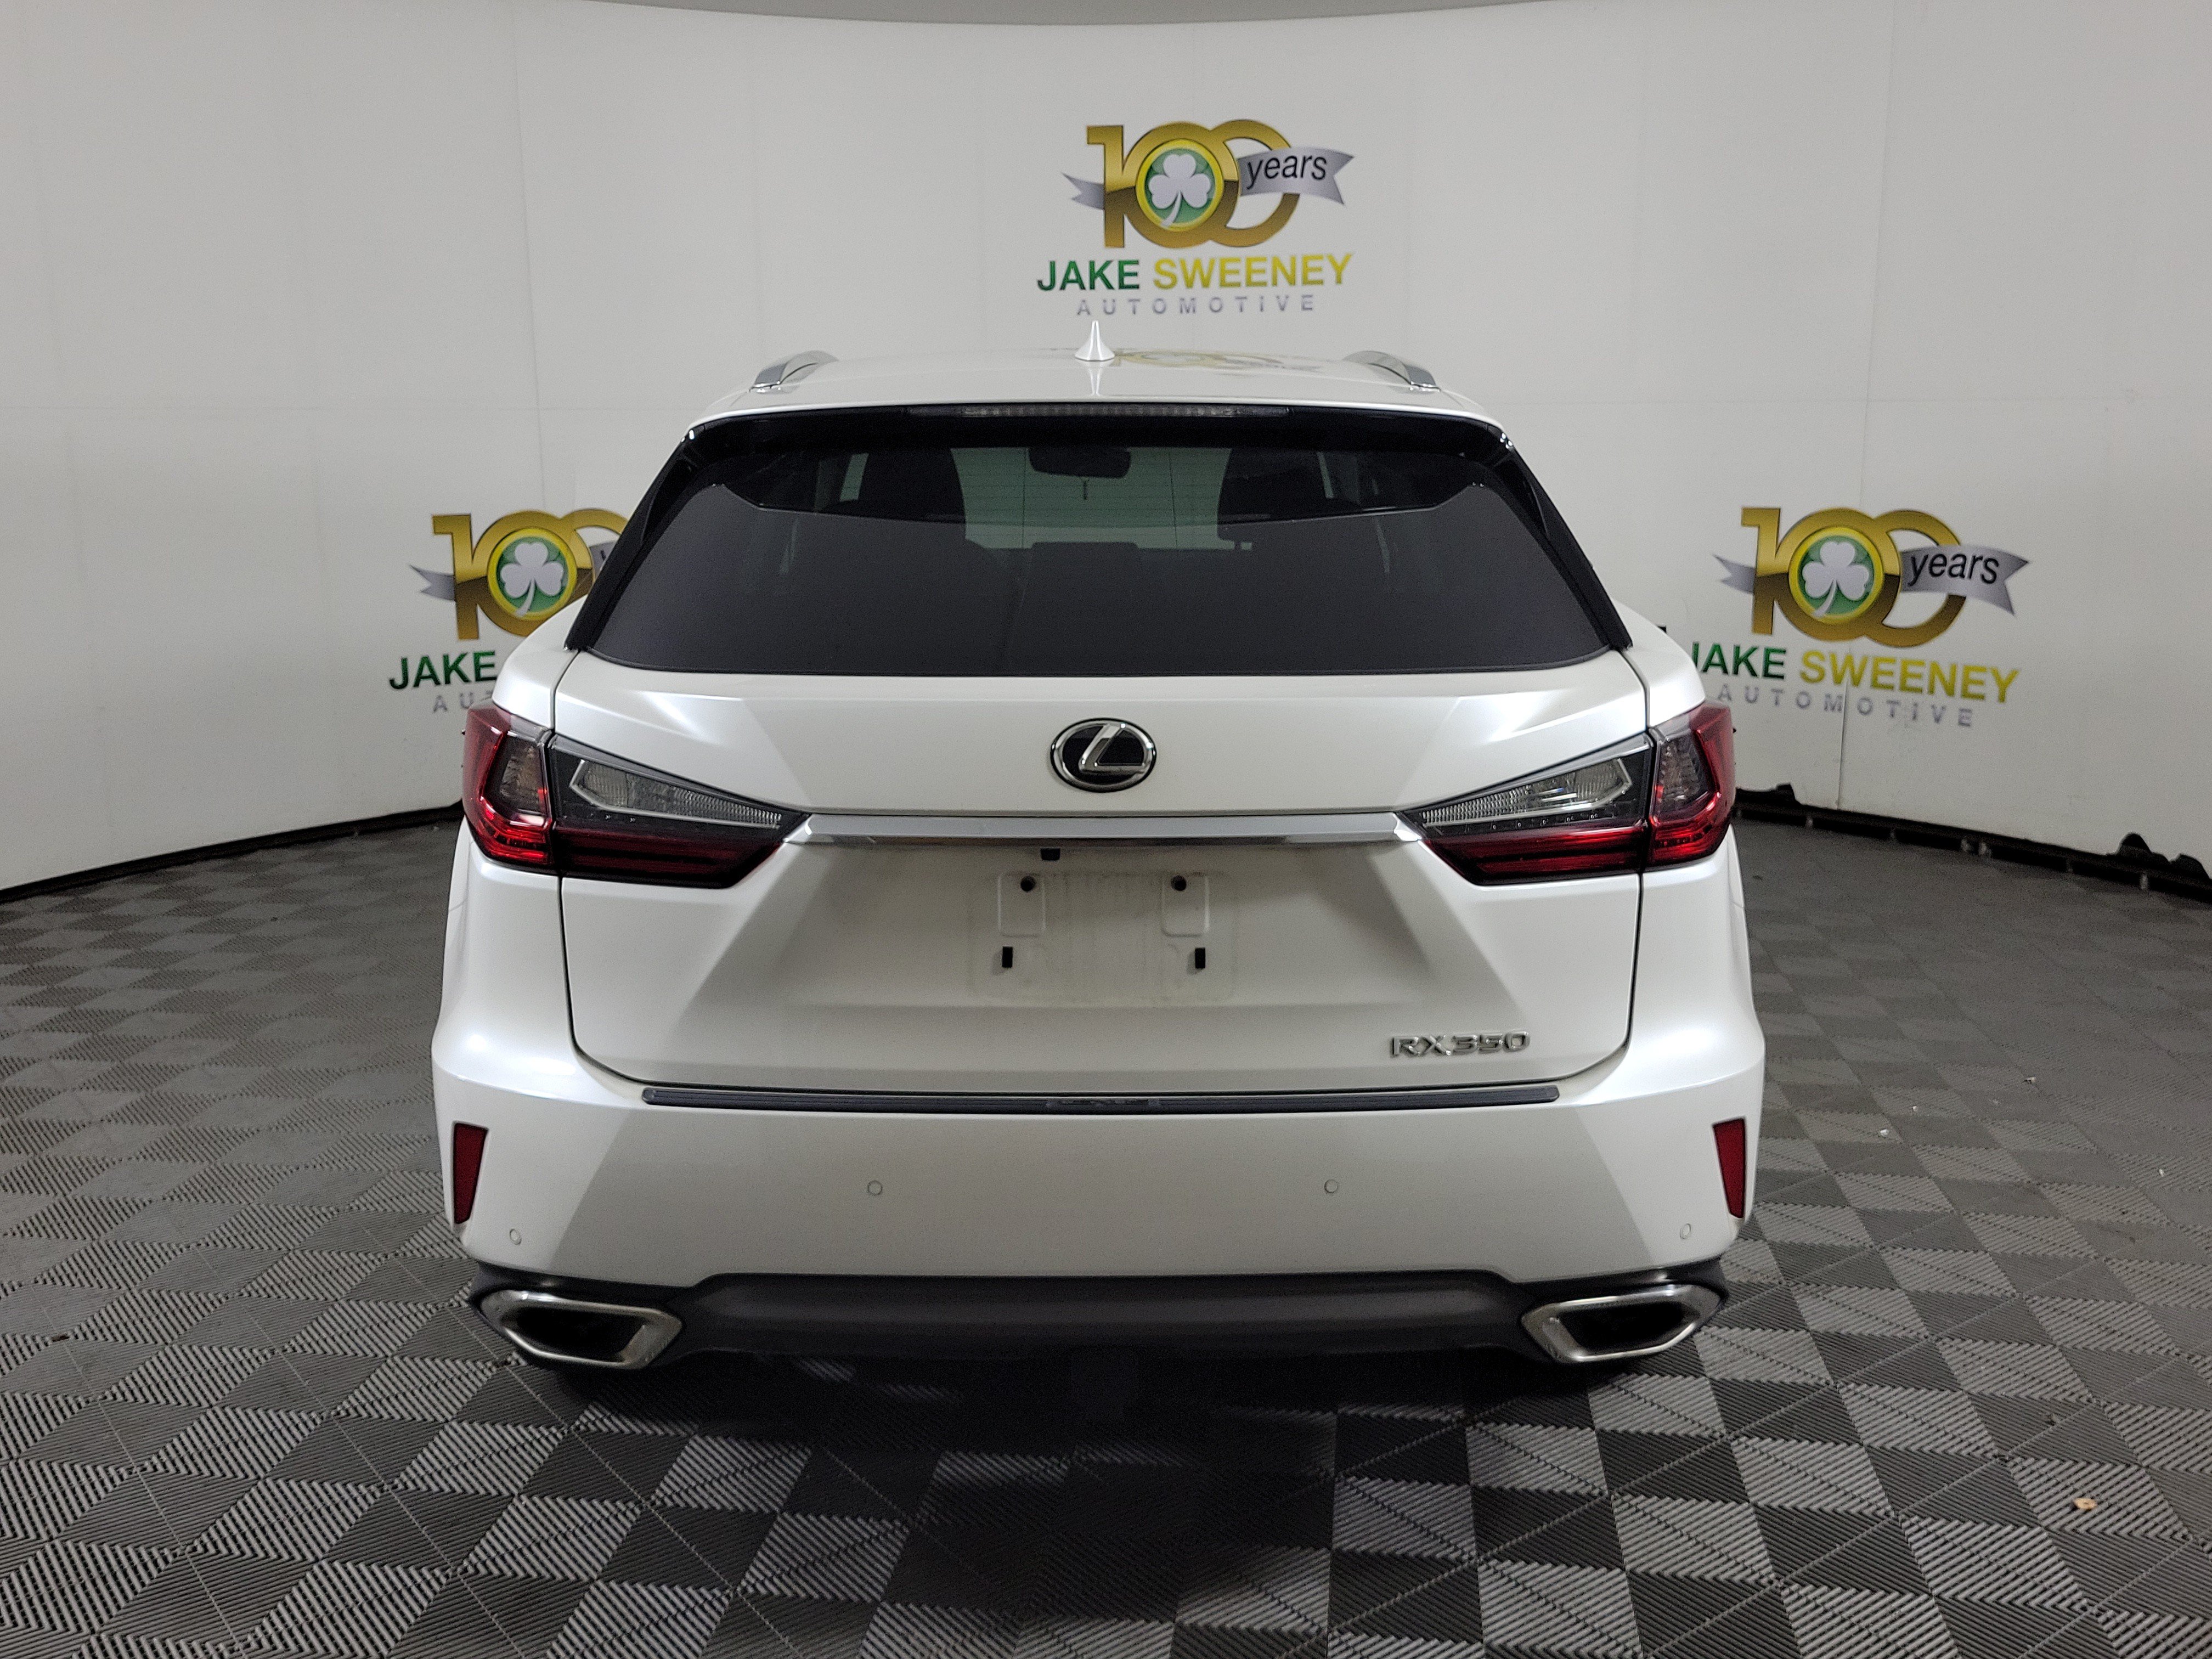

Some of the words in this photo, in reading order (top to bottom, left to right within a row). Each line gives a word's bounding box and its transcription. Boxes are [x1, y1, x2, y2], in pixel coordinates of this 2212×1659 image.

[1086, 119, 1301, 249] 100
[1245, 154, 1327, 189] years
[1037, 259, 1140, 291] JAKE
[1153, 253, 1353, 290] SWEENEY
[1076, 294, 1315, 316] AUTOMOTIVE
[1908, 552, 2000, 587] years
[389, 651, 497, 689] JAKE
[1799, 651, 2019, 703] SWEENEY
[1717, 684, 1974, 728] AUTOMOTIVE
